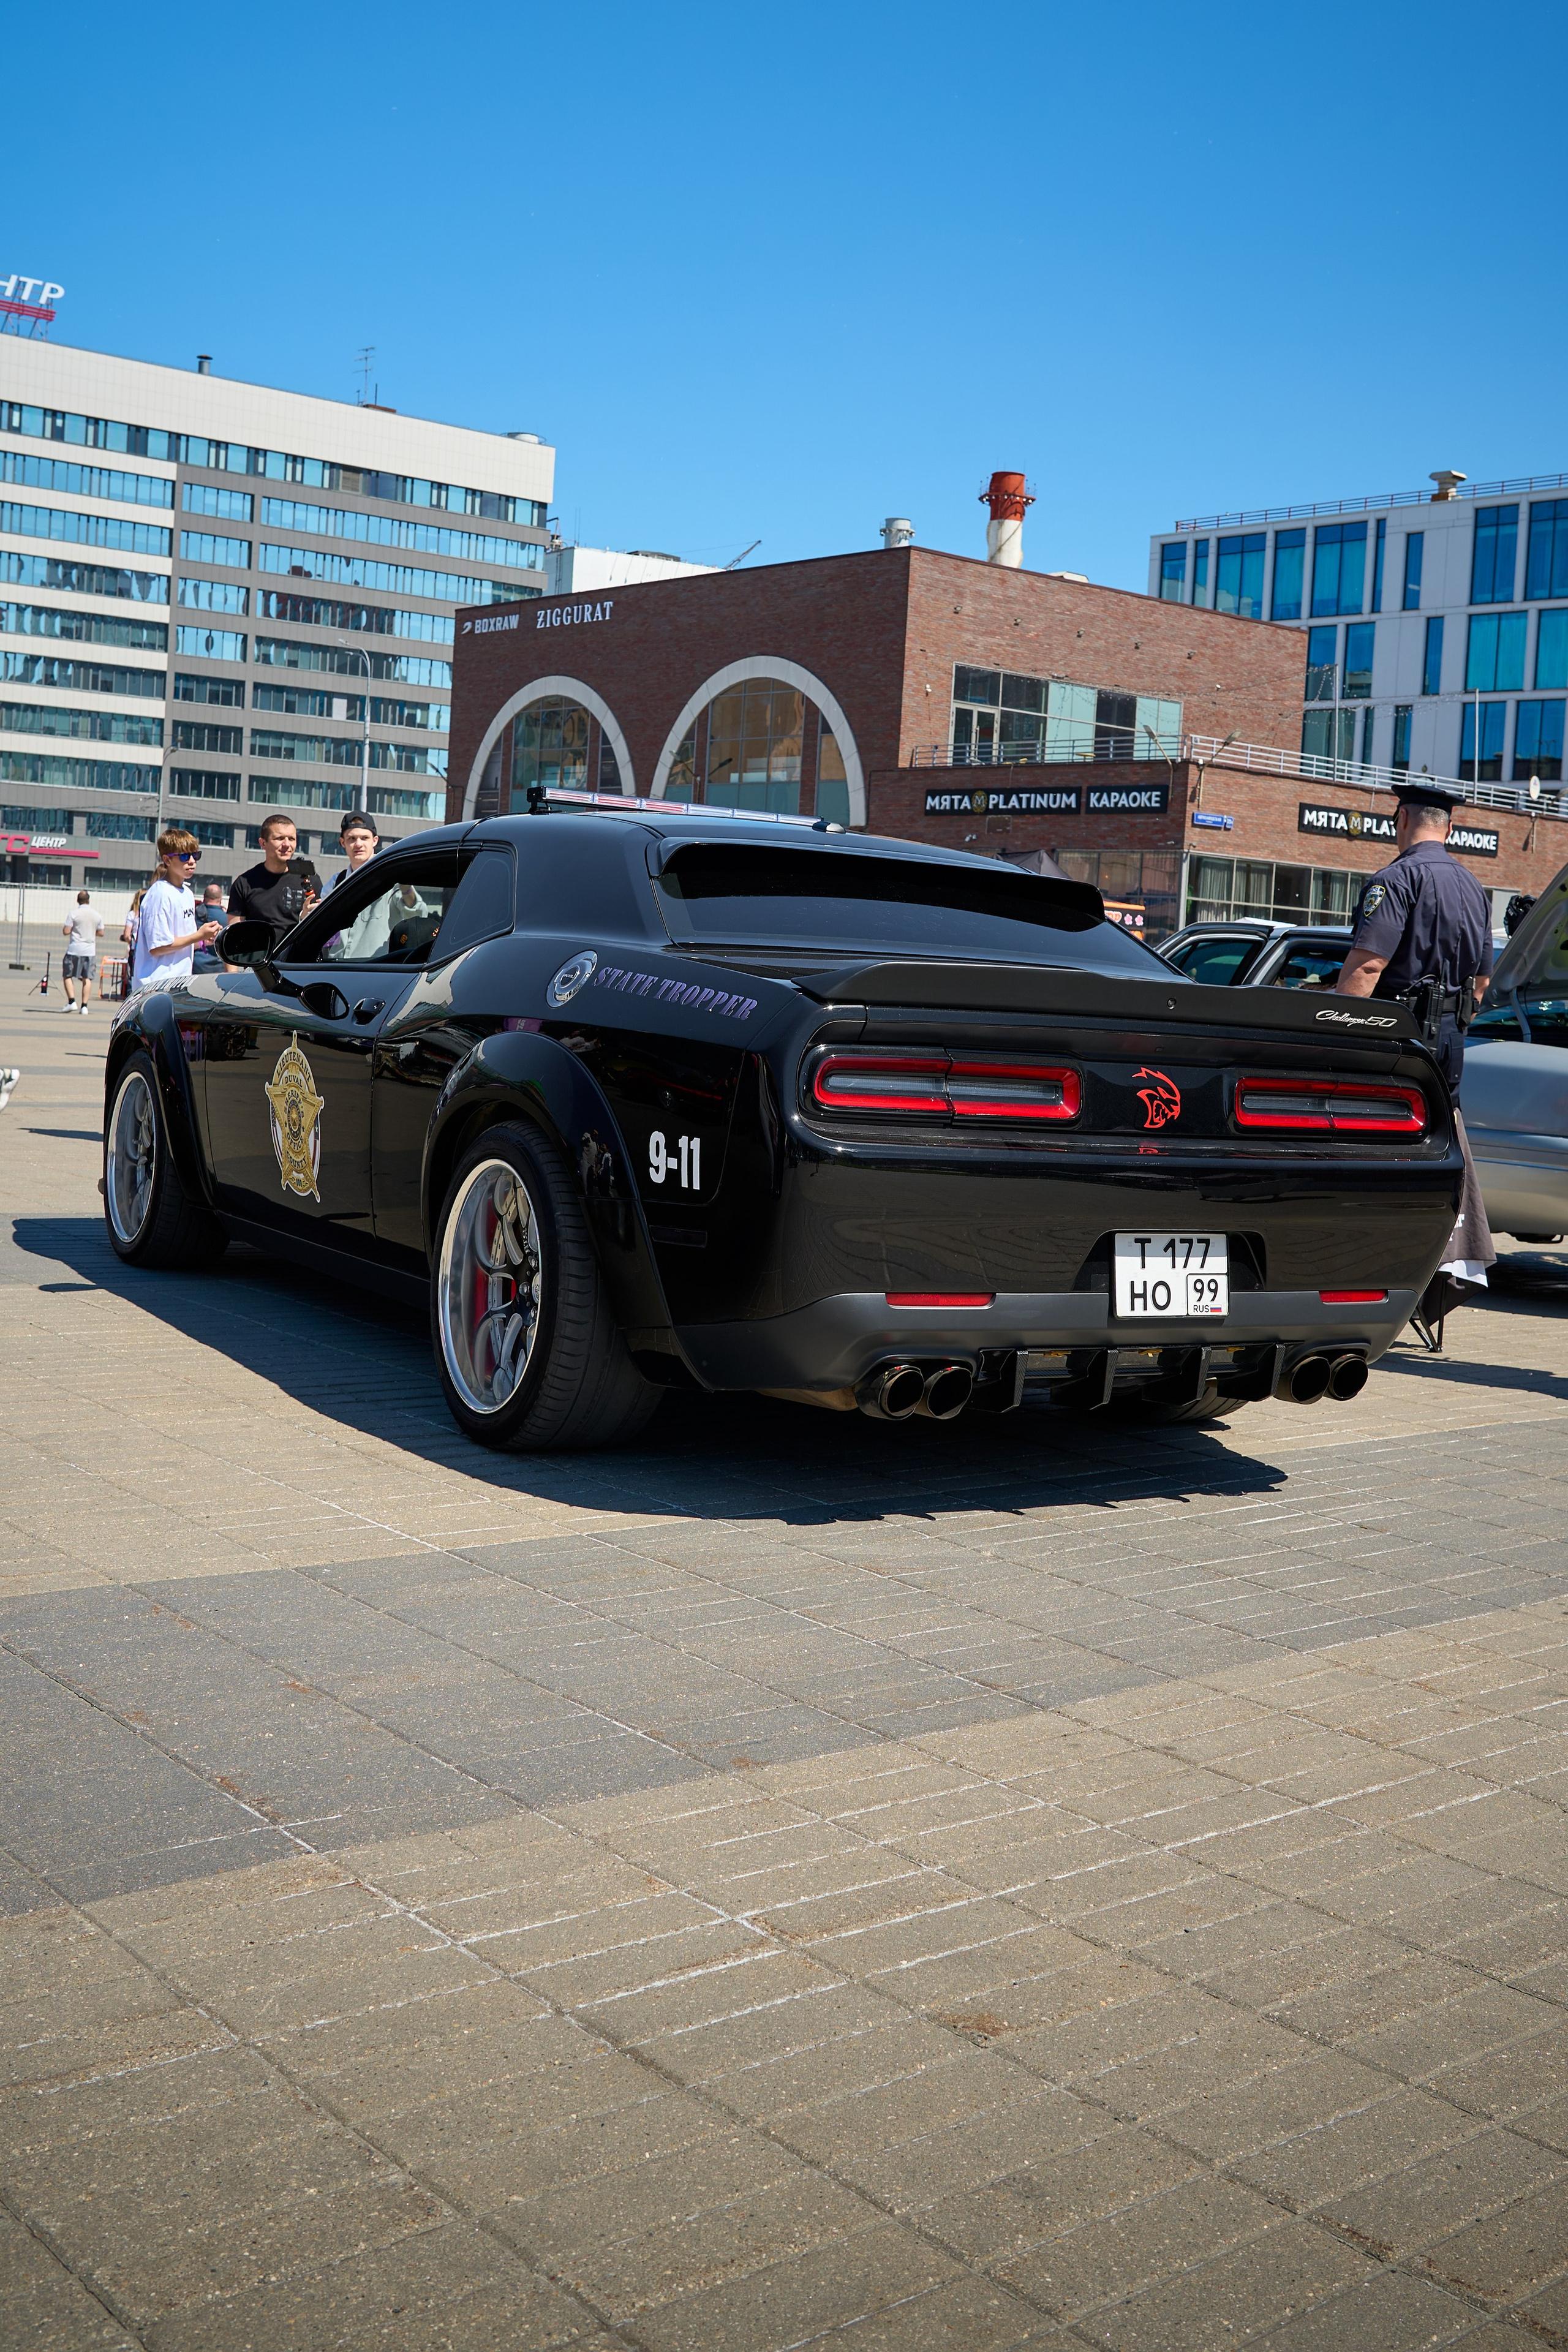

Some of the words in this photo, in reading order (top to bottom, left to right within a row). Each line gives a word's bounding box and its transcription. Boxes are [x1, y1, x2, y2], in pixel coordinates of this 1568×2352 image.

[474, 614, 519, 634] BOXRAW
[536, 601, 613, 628] ZIGGURAT
[925, 795, 971, 810] МЯТА
[988, 793, 1077, 809] PLATINUM
[1089, 791, 1161, 808] КАРАОКЕ
[1303, 809, 1348, 831] МЯТА
[1363, 817, 1396, 837] PLAT
[31, 835, 67, 848] ЦЕНТР
[593, 967, 659, 997] STATE
[652, 978, 758, 1020] TROPPER
[276, 1051, 312, 1084] LIEUTENANT
[284, 1074, 303, 1088] DUVAL
[287, 1132, 304, 1151] OFFICE
[286, 1151, 307, 1169] COUNTY
[649, 1131, 701, 1190] 9-11
[1163, 1238, 1210, 1269] 177
[1193, 1278, 1219, 1302] 99
